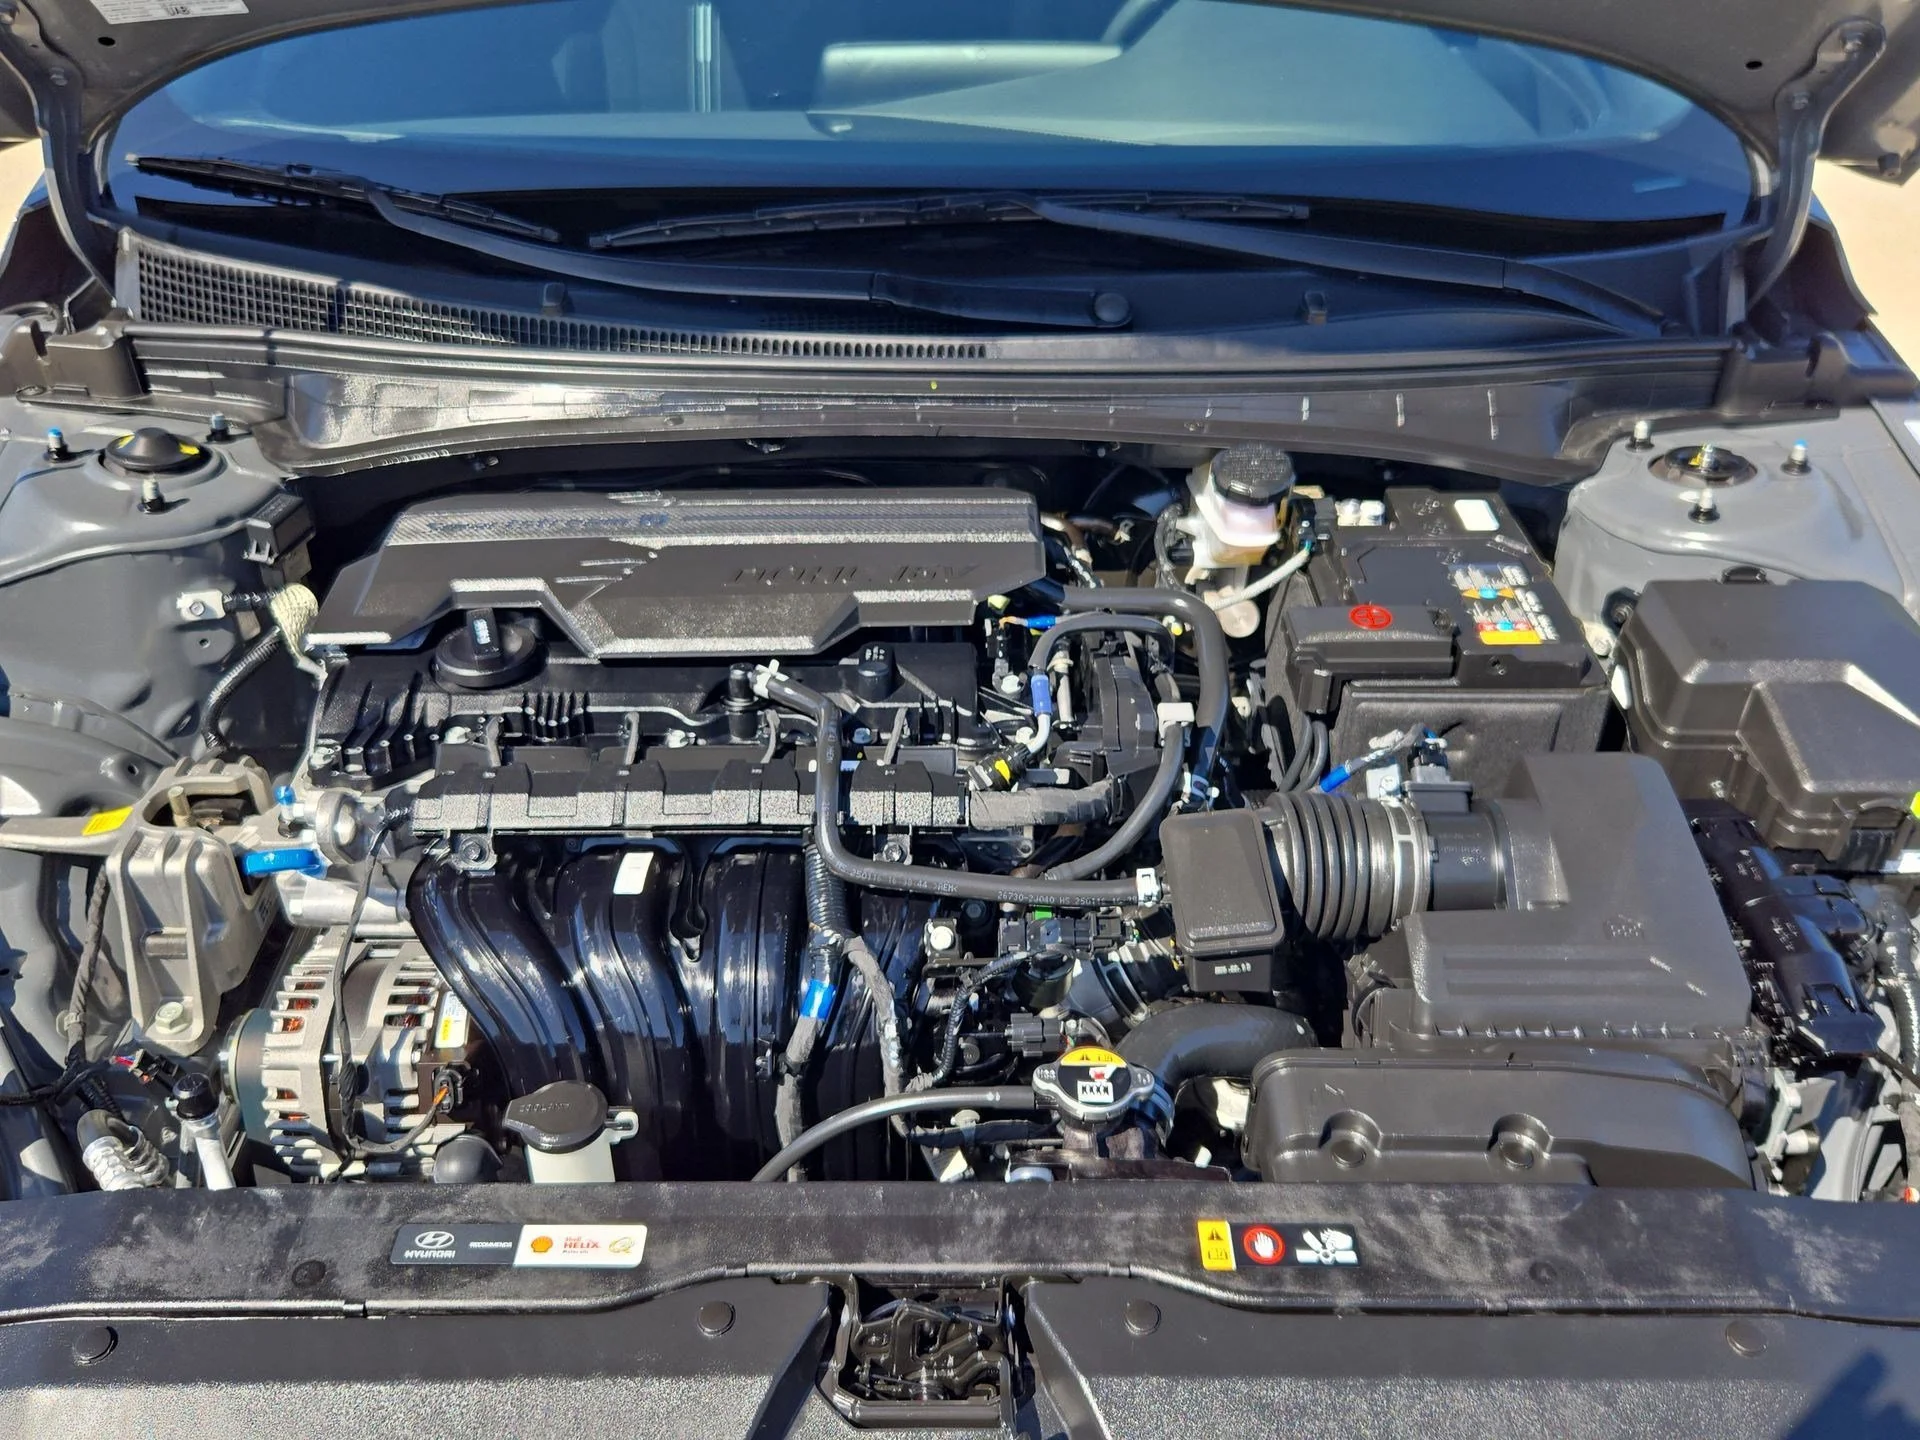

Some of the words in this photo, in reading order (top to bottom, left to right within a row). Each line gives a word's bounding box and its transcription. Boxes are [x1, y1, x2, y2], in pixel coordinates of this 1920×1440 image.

[1059, 895, 1071, 905] HS
[563, 1241, 599, 1249] HELIX
[404, 1249, 457, 1259] HYUNDAI
